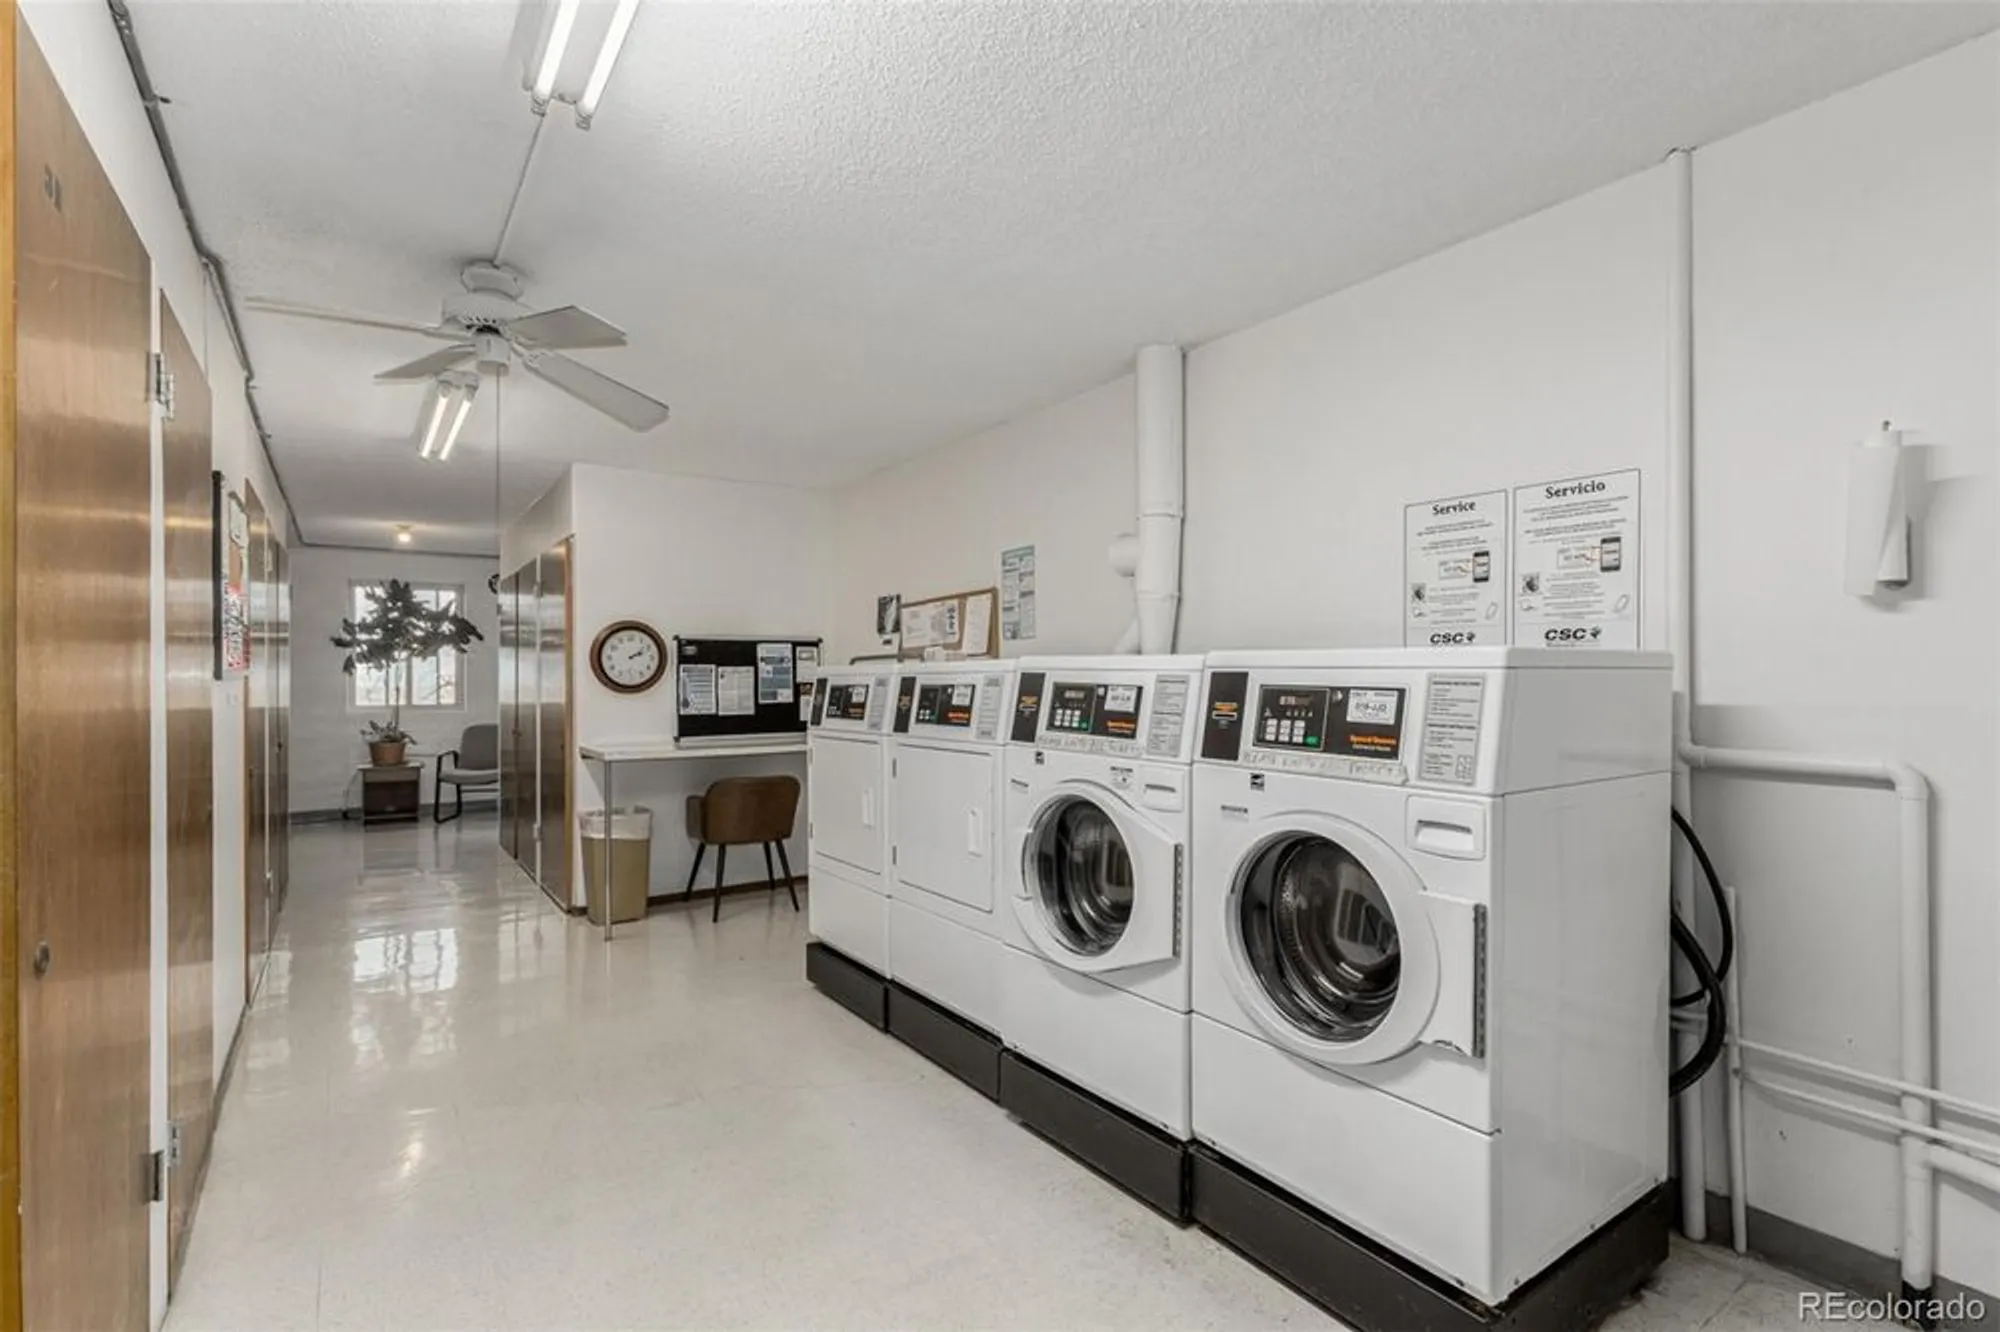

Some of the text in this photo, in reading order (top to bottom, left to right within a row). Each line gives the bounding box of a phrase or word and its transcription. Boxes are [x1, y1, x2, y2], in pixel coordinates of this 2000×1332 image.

[1545, 480, 1606, 499] Servicio
[1432, 501, 1476, 516] Service
[1429, 632, 1465, 645] CSC
[1544, 627, 1587, 641] CSC
